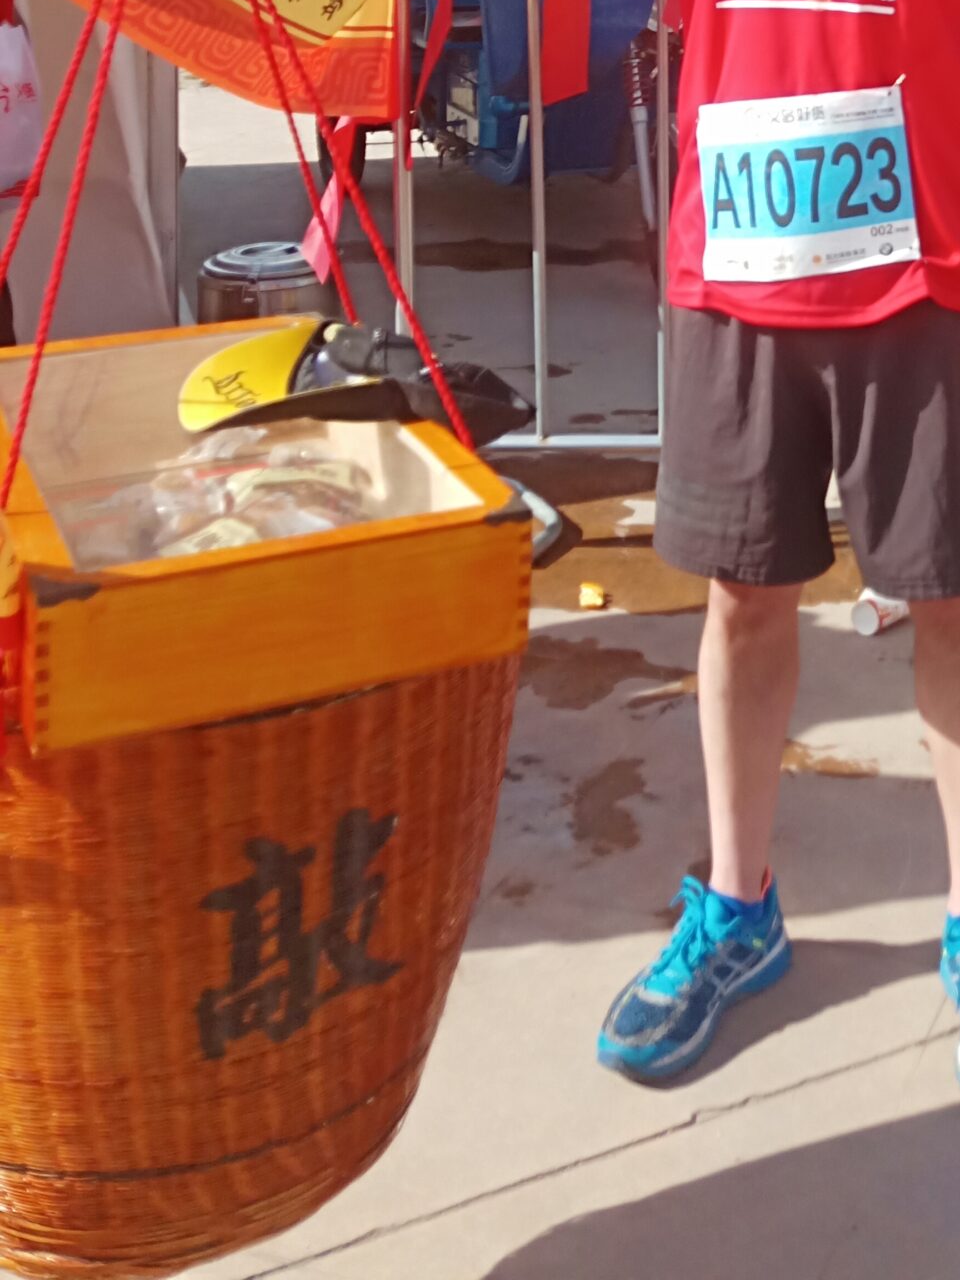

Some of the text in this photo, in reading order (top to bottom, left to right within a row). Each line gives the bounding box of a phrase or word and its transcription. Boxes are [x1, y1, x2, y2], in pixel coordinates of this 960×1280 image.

[712, 136, 901, 230] A10723
[870, 224, 893, 237] 002
[194, 807, 403, 1061] 敲
